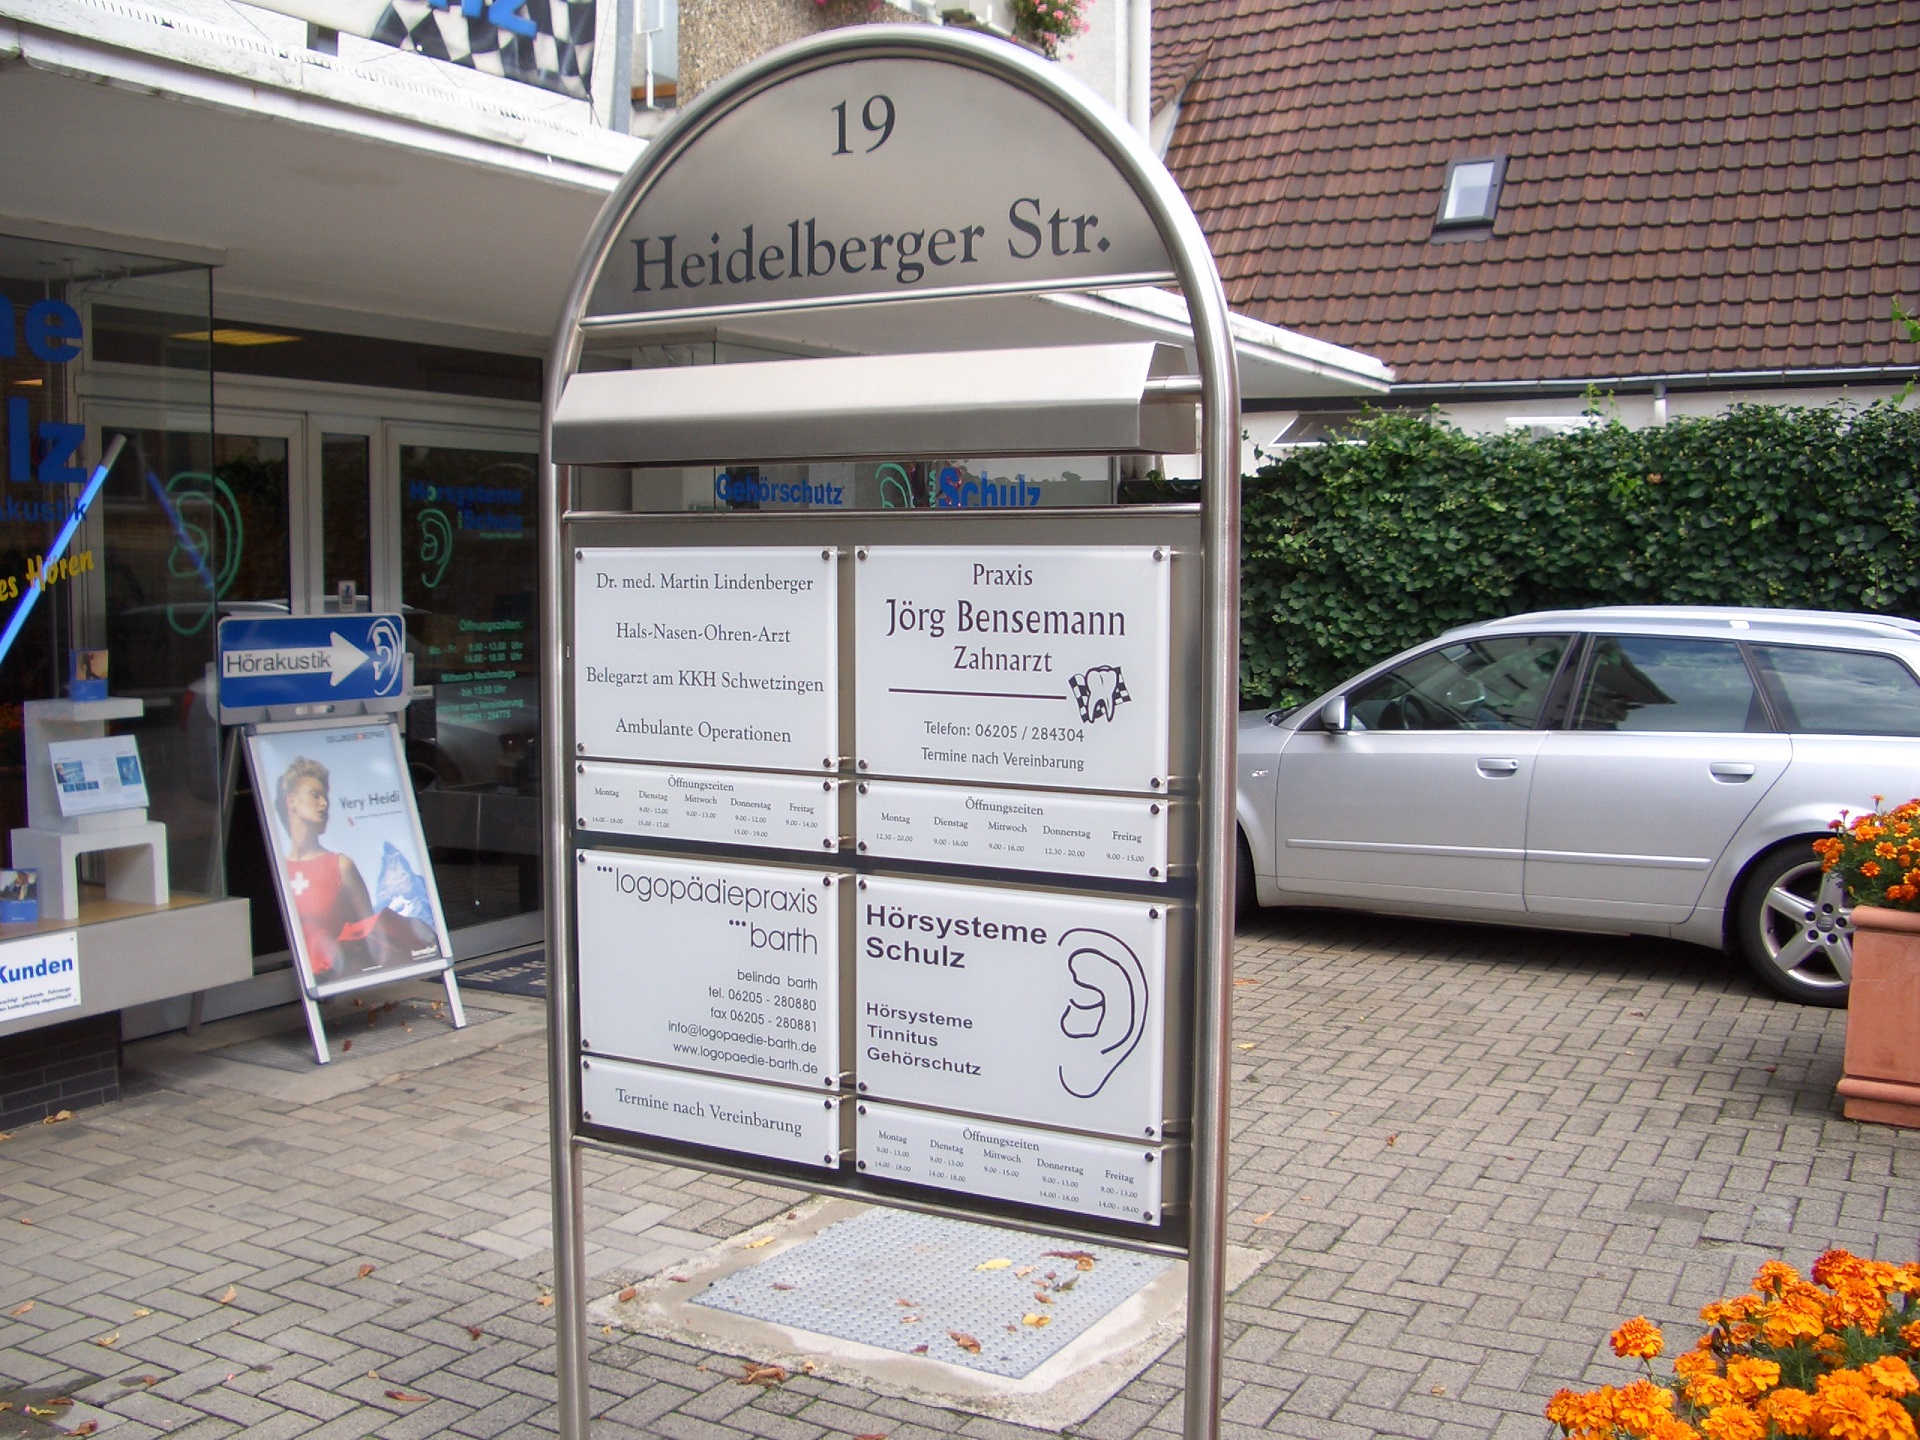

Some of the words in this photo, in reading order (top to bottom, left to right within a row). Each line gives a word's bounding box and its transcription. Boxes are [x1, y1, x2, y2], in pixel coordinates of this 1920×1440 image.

[831, 94, 895, 156] 19
[631, 217, 985, 294] Heidelberger
[1008, 198, 1111, 259] Str.
[716, 473, 843, 506] Gehörschutz
[938, 466, 1041, 507] Schulz
[26, 550, 94, 593] Hören
[596, 572, 617, 589] Dr.
[622, 573, 655, 589] med.
[661, 573, 709, 590] Martin
[714, 573, 814, 594] Lindenberger
[973, 563, 1033, 586] Praxis
[886, 598, 946, 638] Jörg
[957, 599, 1126, 636] Bensemann
[616, 622, 791, 643] Hals-Nasen-Ohren-Arzt
[226, 651, 331, 674] Hörakustik
[953, 645, 1053, 673] Zahnarzt
[586, 666, 648, 687] Belegarzt
[652, 672, 674, 686] am
[678, 669, 716, 688] KKH
[721, 671, 824, 696] Schwetzingen
[615, 717, 694, 737] Ambulante
[698, 721, 792, 743] Operationen
[924, 721, 970, 737] Telefon:
[975, 724, 1018, 739] 06205
[1022, 726, 1028, 741] /
[1031, 726, 1085, 742] 284304
[921, 747, 967, 763] Termine
[971, 750, 999, 766] nach
[1003, 752, 1085, 771] Vereinbarung
[667, 774, 734, 792] Öffnungszeiten
[339, 796, 365, 811] Very
[368, 790, 400, 806] Heidi
[594, 787, 619, 798] Montag
[639, 790, 668, 801] Dienstag
[684, 794, 718, 805] Mittwoch
[730, 798, 771, 810] Donnerstag
[789, 802, 814, 815] Freitag
[965, 796, 1044, 815] Öffnungszeiten
[881, 812, 911, 824] Montag
[934, 817, 968, 829] Dienstag
[988, 821, 1027, 833] Mittwoch
[1043, 825, 1091, 839] Donnerstag
[1112, 830, 1142, 843] Freitag
[1007, 844, 1024, 852] 16.00
[1106, 852, 1120, 860] 9.00
[866, 903, 1048, 945] Hörsysteme
[866, 936, 966, 969] Schulz
[737, 969, 780, 985] belinda
[787, 975, 818, 990] barth
[708, 986, 724, 999] tel.
[728, 988, 763, 1004] 06205
[773, 995, 817, 1011] 280880
[710, 1006, 727, 1019] fax
[730, 1009, 765, 1025] 06205
[775, 1016, 817, 1032] 280881
[866, 1002, 974, 1029] Hörsysteme
[668, 1020, 817, 1054] info@logopaedie-barth.de
[867, 1024, 938, 1047] Tinnitus
[673, 1042, 818, 1075] www.logopaedie-barth.de
[867, 1047, 982, 1076] Gehörschutz
[615, 1088, 669, 1111] Termine
[673, 1101, 705, 1117] nach
[709, 1103, 802, 1137] Vereinbarung
[962, 1127, 1040, 1152] Öffnungszeiten
[878, 1130, 907, 1144] Montag
[930, 1140, 964, 1155] Dienstag
[983, 1149, 1021, 1163] Mittwoch
[1037, 1158, 1084, 1176] Donnerstag
[1105, 1169, 1134, 1184] Freitag
[1042, 1176, 1056, 1184] 9.00
[1061, 1180, 1079, 1188] 13.00
[1100, 1186, 1115, 1194] 9.00
[1040, 1190, 1057, 1199] 14.00
[1099, 1201, 1116, 1209] 14.00
